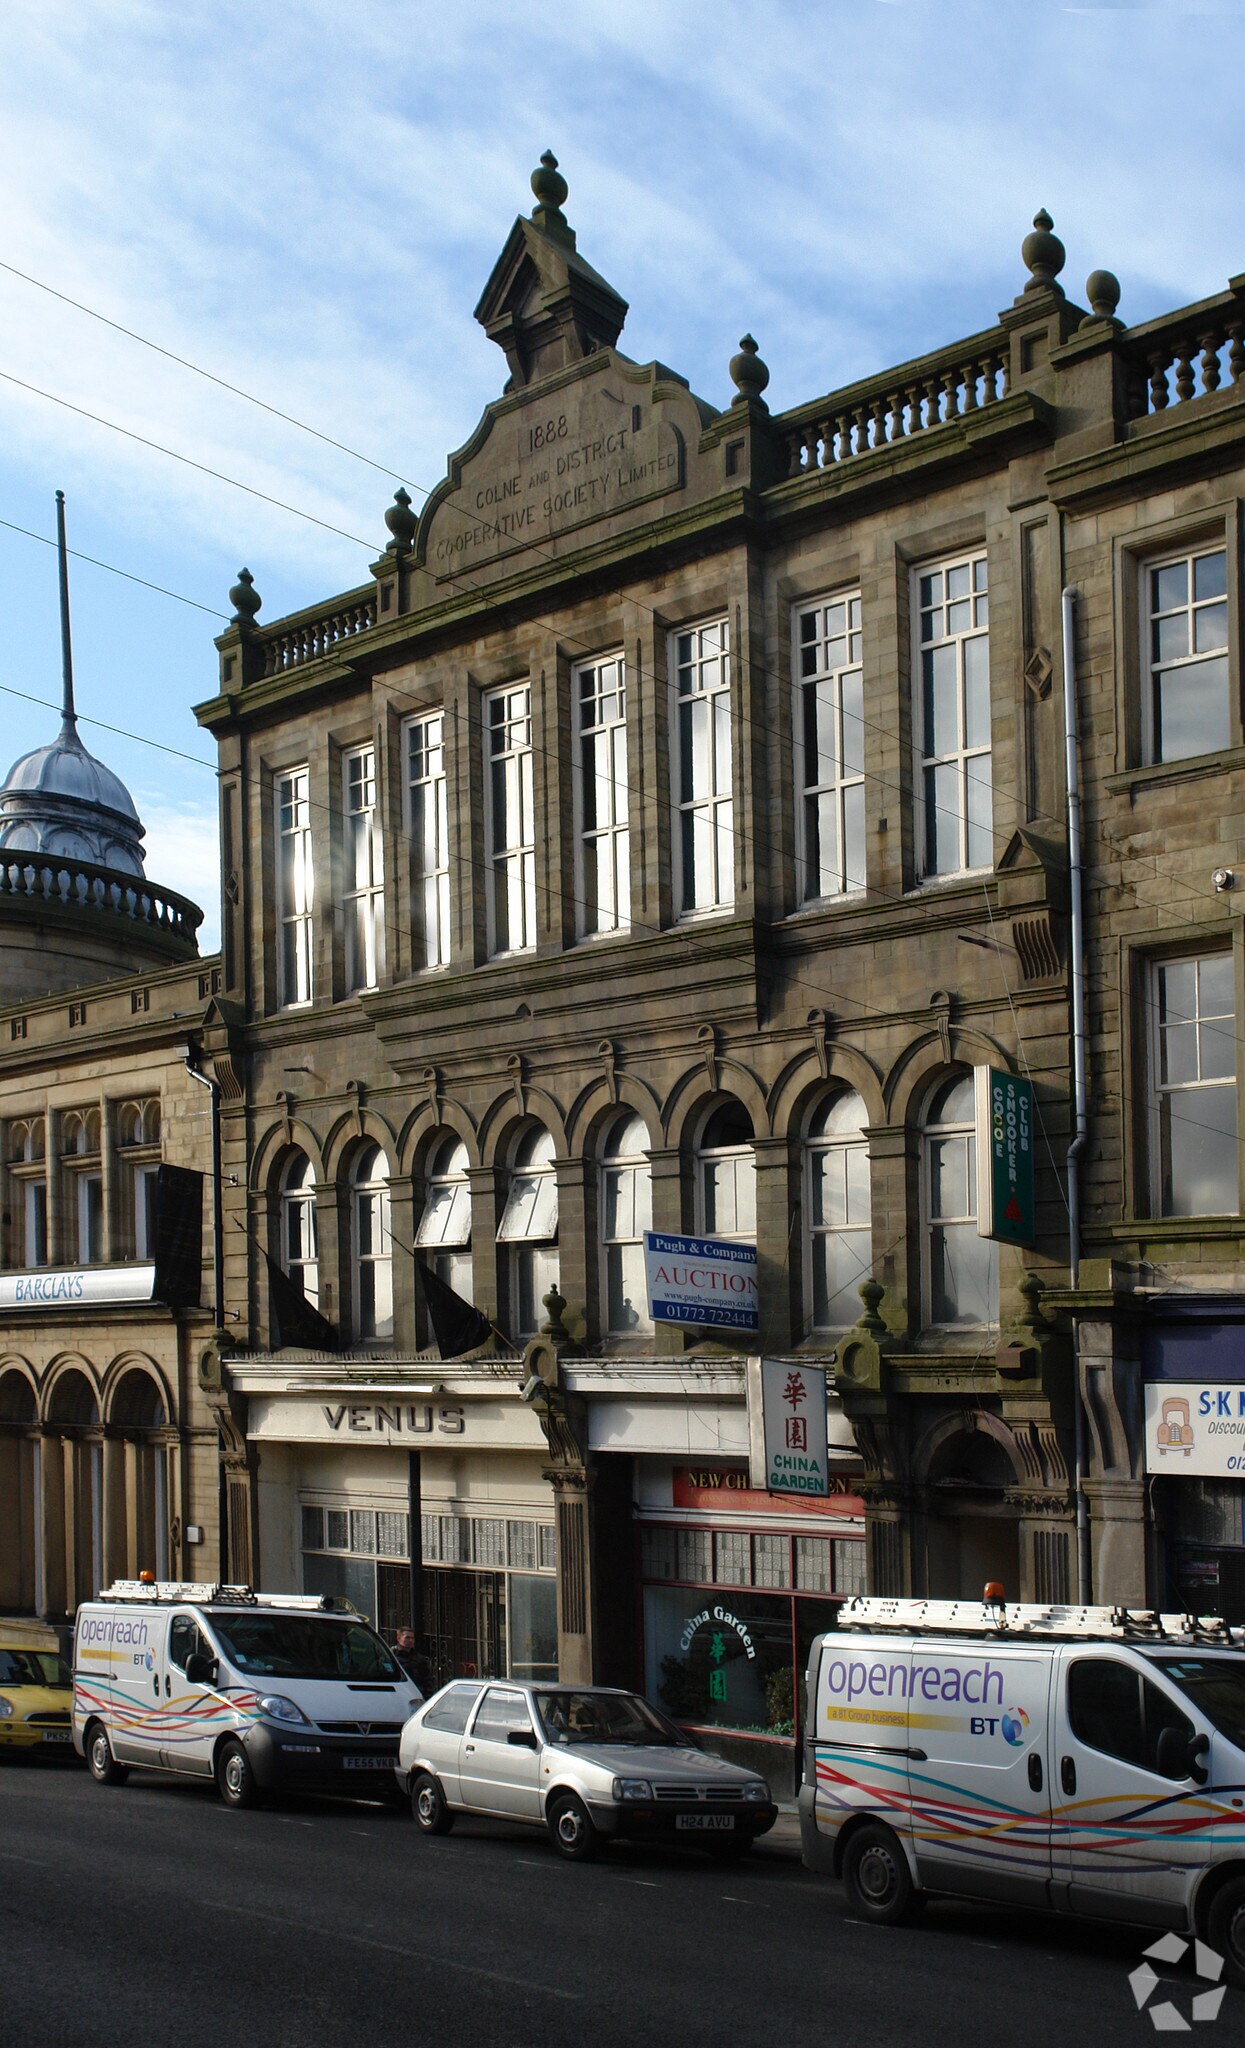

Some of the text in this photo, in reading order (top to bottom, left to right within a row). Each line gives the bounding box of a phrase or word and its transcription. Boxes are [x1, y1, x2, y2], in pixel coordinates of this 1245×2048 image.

[529, 415, 568, 452] 1888
[476, 430, 627, 509] COLNE AND DISTRICT
[543, 473, 609, 518] SOCIETY
[618, 453, 676, 487] LIMITED
[1006, 1084, 1017, 1182] SNOOKER
[1019, 1096, 1029, 1151] CLUB
[655, 1238, 757, 1262] Pugh & Company
[15, 1275, 84, 1301] BARCLAYS
[655, 1266, 758, 1294] AUCTION
[666, 1304, 753, 1326] 01772 722444
[321, 1405, 465, 1433] VENUS
[774, 1455, 820, 1473] CHINA
[688, 1472, 722, 1488] NEW
[770, 1473, 825, 1492] GARDEN
[81, 1618, 148, 1645] openreach
[681, 1606, 756, 1659] China Garden
[133, 1653, 145, 1665] BT
[828, 1661, 1004, 1705] openreach
[838, 1710, 847, 1719] BT
[848, 1710, 871, 1723] Group
[872, 1711, 905, 1725] business
[970, 1717, 1000, 1736] BT
